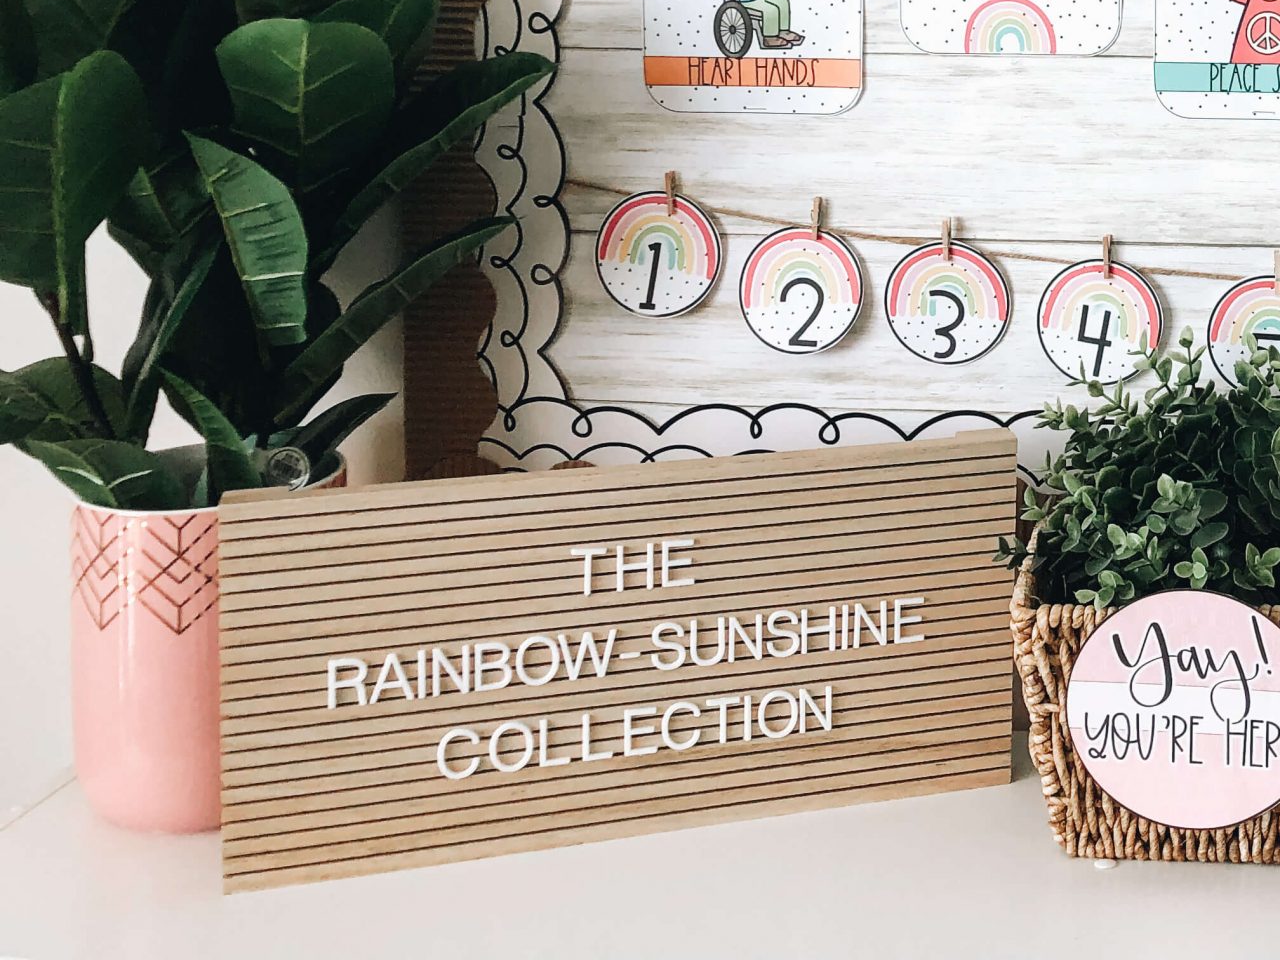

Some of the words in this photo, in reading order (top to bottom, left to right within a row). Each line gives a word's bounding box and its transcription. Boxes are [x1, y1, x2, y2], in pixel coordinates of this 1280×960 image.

[687, 57, 749, 87] HEART
[756, 58, 819, 87] HANDS
[1209, 66, 1268, 94] PEACE
[639, 242, 663, 310] 1
[780, 277, 825, 348] 2
[929, 290, 965, 358] 3
[1077, 304, 1112, 377] 4
[571, 538, 696, 597] THE
[326, 596, 926, 710] RAINBOW-SUNSHINE
[1112, 615, 1274, 724] Yay!
[437, 685, 835, 781] COLLECTION
[1085, 711, 1204, 764] YOU'RE
